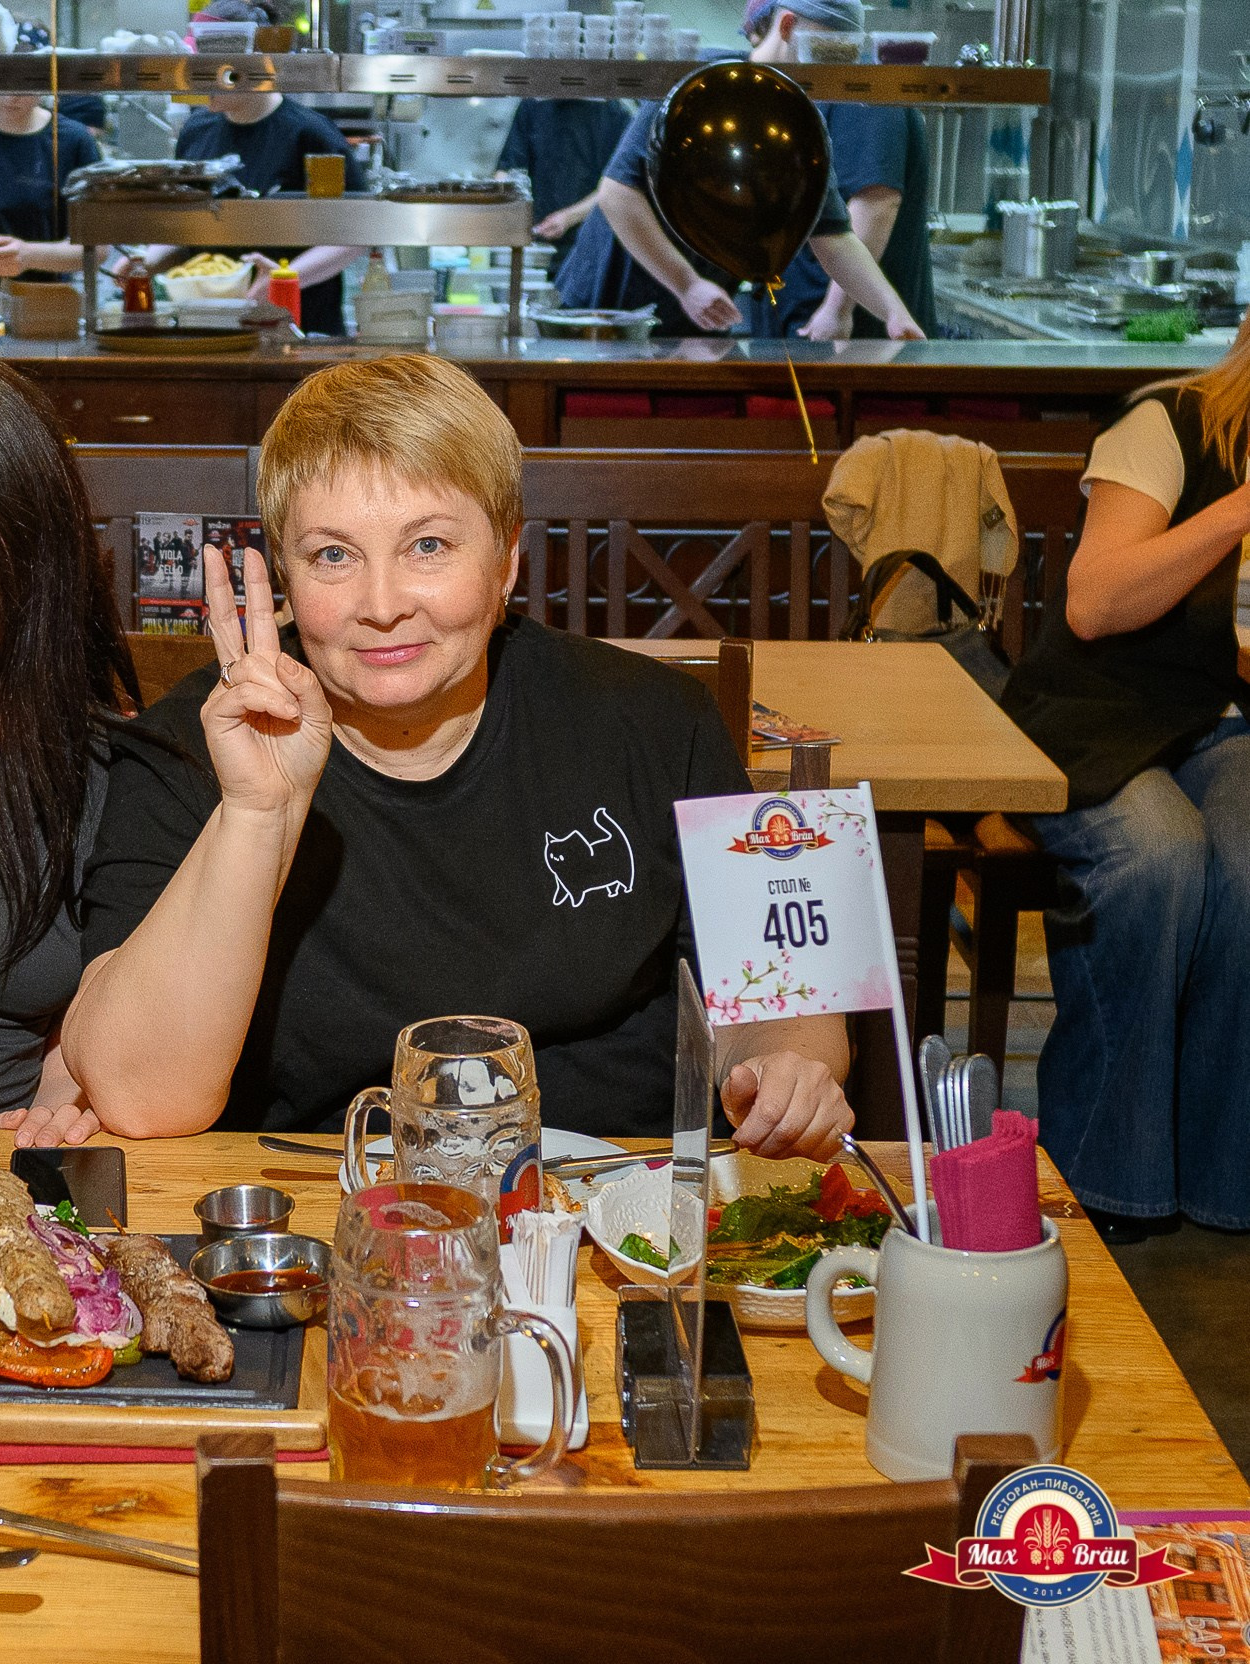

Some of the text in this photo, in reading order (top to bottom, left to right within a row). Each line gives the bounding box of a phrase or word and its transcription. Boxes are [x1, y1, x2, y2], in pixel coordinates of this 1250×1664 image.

[159, 549, 183, 561] VIOLA
[748, 832, 771, 845] Max
[767, 877, 812, 896] СТОЛ №
[763, 898, 830, 950] 405
